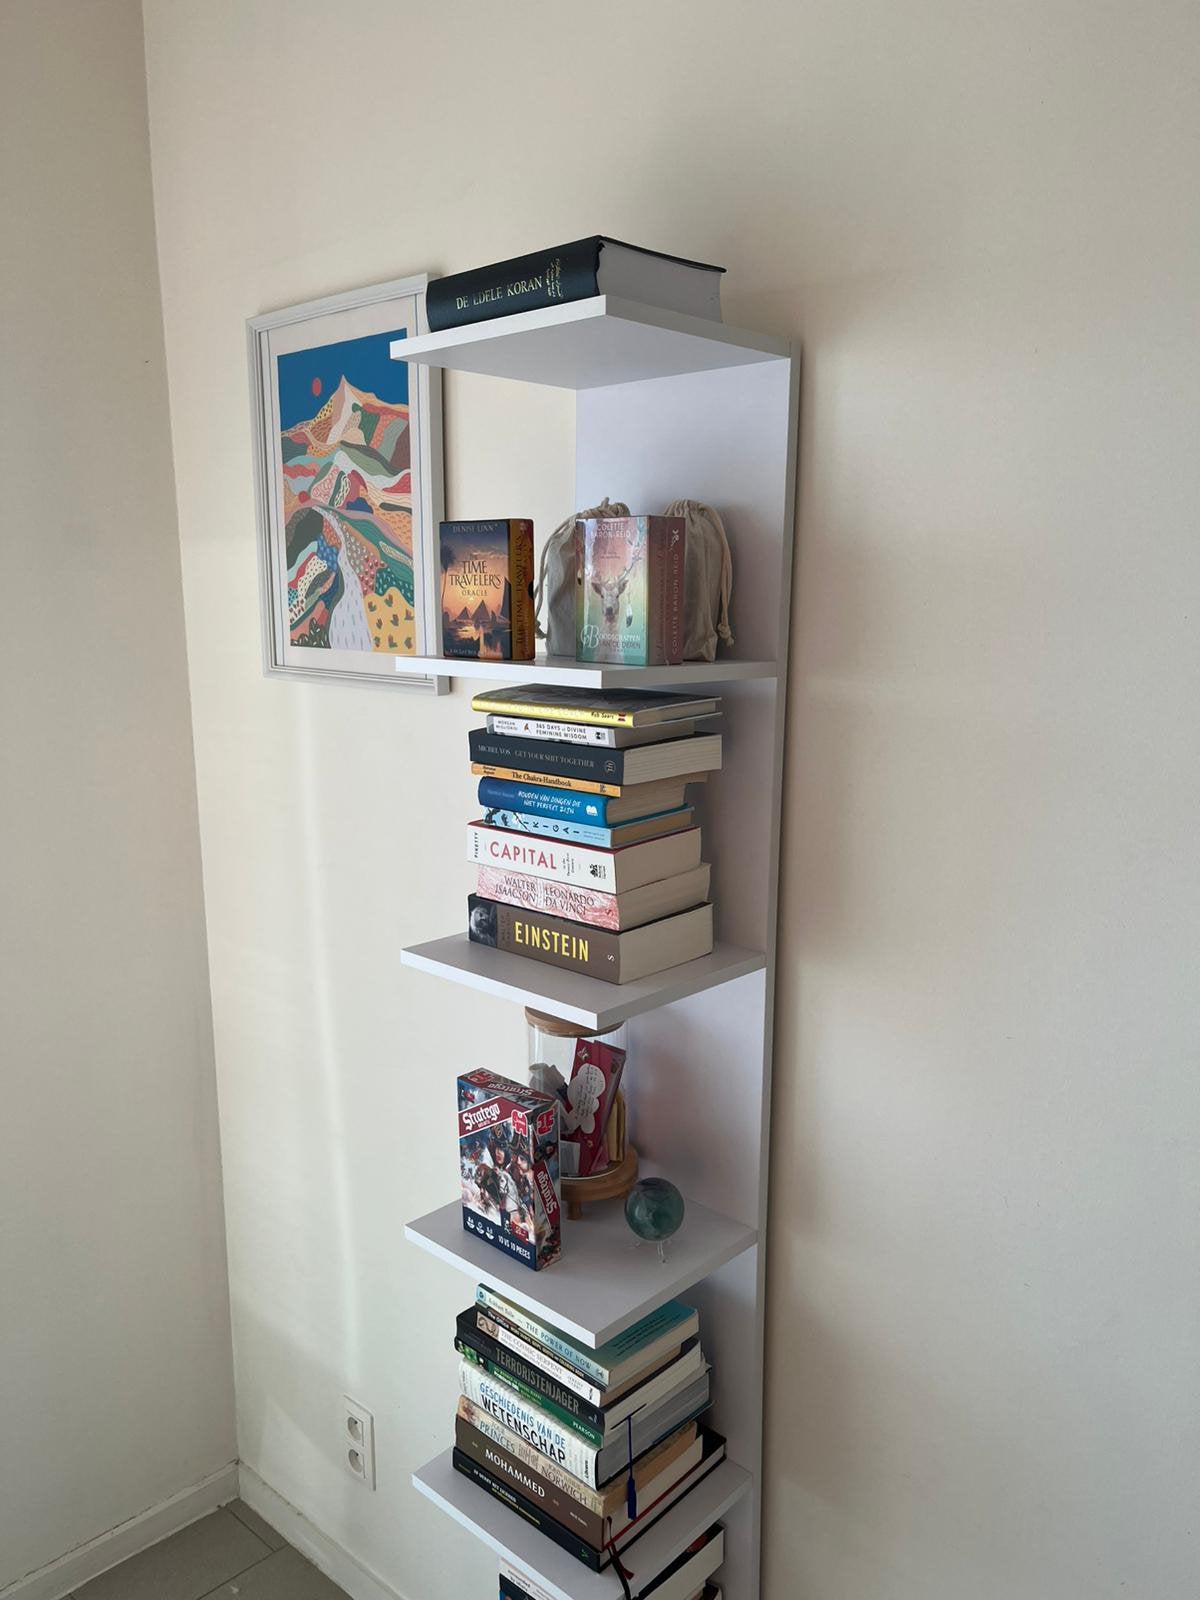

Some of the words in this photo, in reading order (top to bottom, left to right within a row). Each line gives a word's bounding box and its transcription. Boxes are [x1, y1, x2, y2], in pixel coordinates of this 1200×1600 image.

[456, 296, 469, 310] DE
[473, 287, 503, 306] EDELE
[507, 276, 542, 297] KORAN
[597, 522, 625, 531] COLETTE
[461, 560, 488, 574] TIME
[449, 574, 502, 590] TRAVELER'S
[461, 589, 488, 597] ORACLE
[536, 729, 562, 737] FEMININE
[563, 731, 587, 740] WISDOM
[547, 723, 561, 731] DAYS
[567, 726, 587, 734] DIVINE
[528, 751, 544, 760] YOUR
[560, 755, 594, 768] TOGETHER
[512, 771, 522, 779] The
[523, 773, 542, 782] Chakra
[543, 776, 571, 787] Handbook
[518, 791, 539, 800] HOUDEN
[551, 795, 571, 806] DINGEN
[572, 799, 581, 807] DIE
[523, 799, 536, 807] NIET
[536, 801, 558, 811] PERFECT
[559, 806, 575, 815] ZIJN
[490, 841, 557, 869] CAPITAL
[495, 884, 537, 902] ISAACSON
[504, 876, 537, 892] WALTER
[545, 886, 595, 906] LEONARDO
[545, 897, 557, 907] DA
[560, 900, 586, 915] VINCI
[514, 921, 589, 962] EINSTEIN
[462, 1103, 501, 1131] Stratego
[536, 1171, 557, 1214] Stratego
[498, 1235, 503, 1244] 10
[504, 1240, 510, 1248] VS
[510, 1242, 516, 1251] 10
[525, 1322, 539, 1336] THE
[541, 1330, 563, 1351] POWER
[564, 1349, 574, 1358] OF
[575, 1354, 592, 1370] NOW
[496, 1347, 579, 1415] TERRORISTENJAGER
[480, 1382, 535, 1428] GESCHIEDENIS
[537, 1421, 552, 1438] VAN
[555, 1436, 566, 1450] DE
[481, 1394, 566, 1464] WETENSCHAP
[572, 1421, 595, 1440] PEARSON
[485, 1448, 545, 1498] MOHAMMED
[541, 1465, 587, 1505] NORWICH
